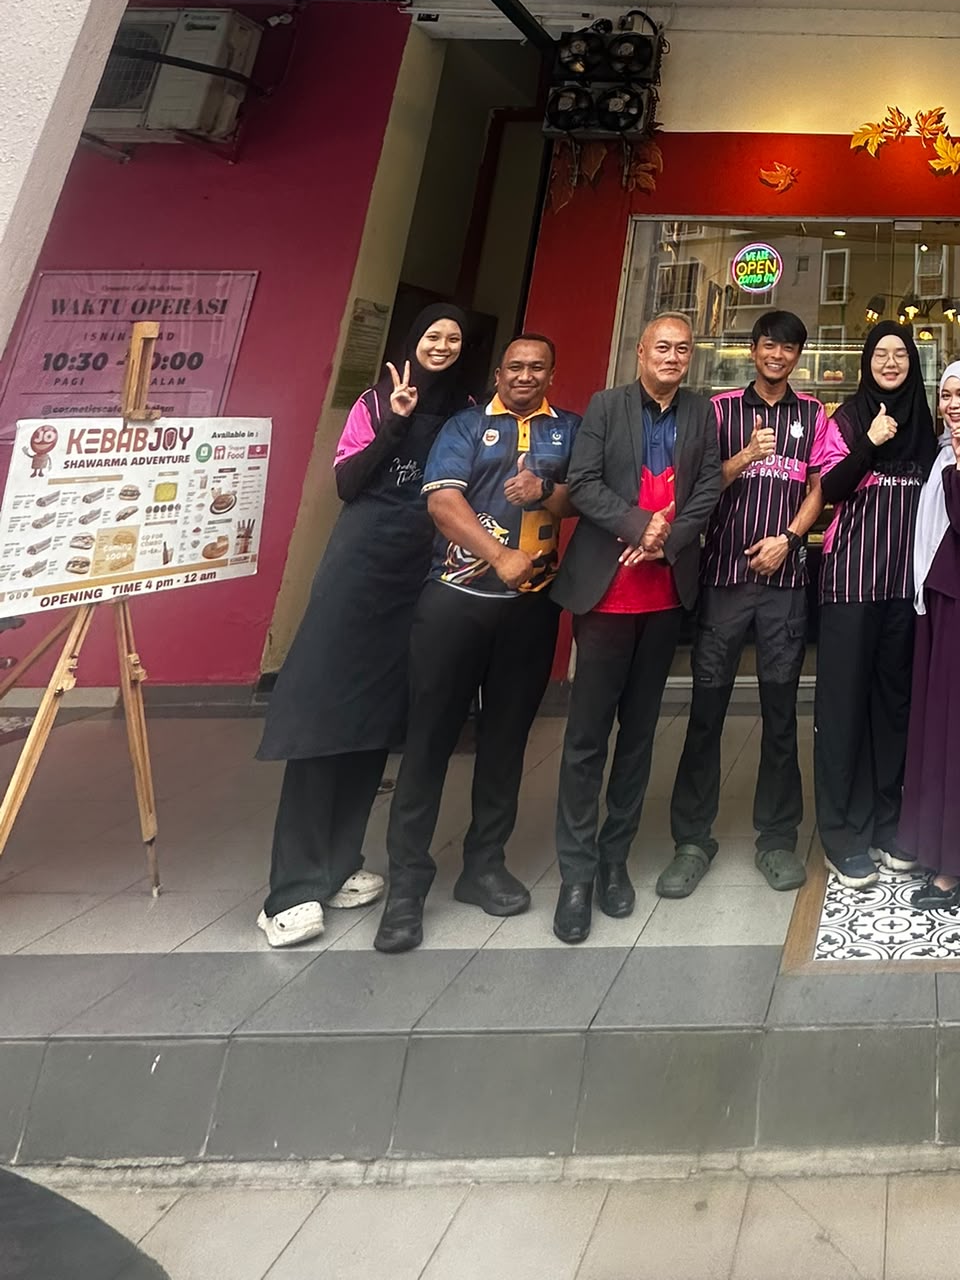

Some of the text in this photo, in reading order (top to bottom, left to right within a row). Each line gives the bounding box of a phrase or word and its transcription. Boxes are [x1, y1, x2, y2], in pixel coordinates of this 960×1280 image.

[736, 259, 777, 276] OPEN
[51, 298, 229, 315] WAKTU OPERASI
[42, 352, 109, 371] 10:30
[54, 377, 186, 386] PAGI ALAM
[66, 427, 194, 455] KEBABJOY
[63, 455, 191, 469] SHAWARMA ADVENTURE
[227, 451, 245, 459] Food
[760, 467, 789, 481] BAKR
[879, 476, 897, 487] THE
[40, 587, 103, 608] OPENING
[112, 581, 142, 596] TIME
[145, 580, 152, 589] 4
[156, 577, 173, 590] pm
[184, 573, 198, 583] 12
[199, 571, 217, 581] am
